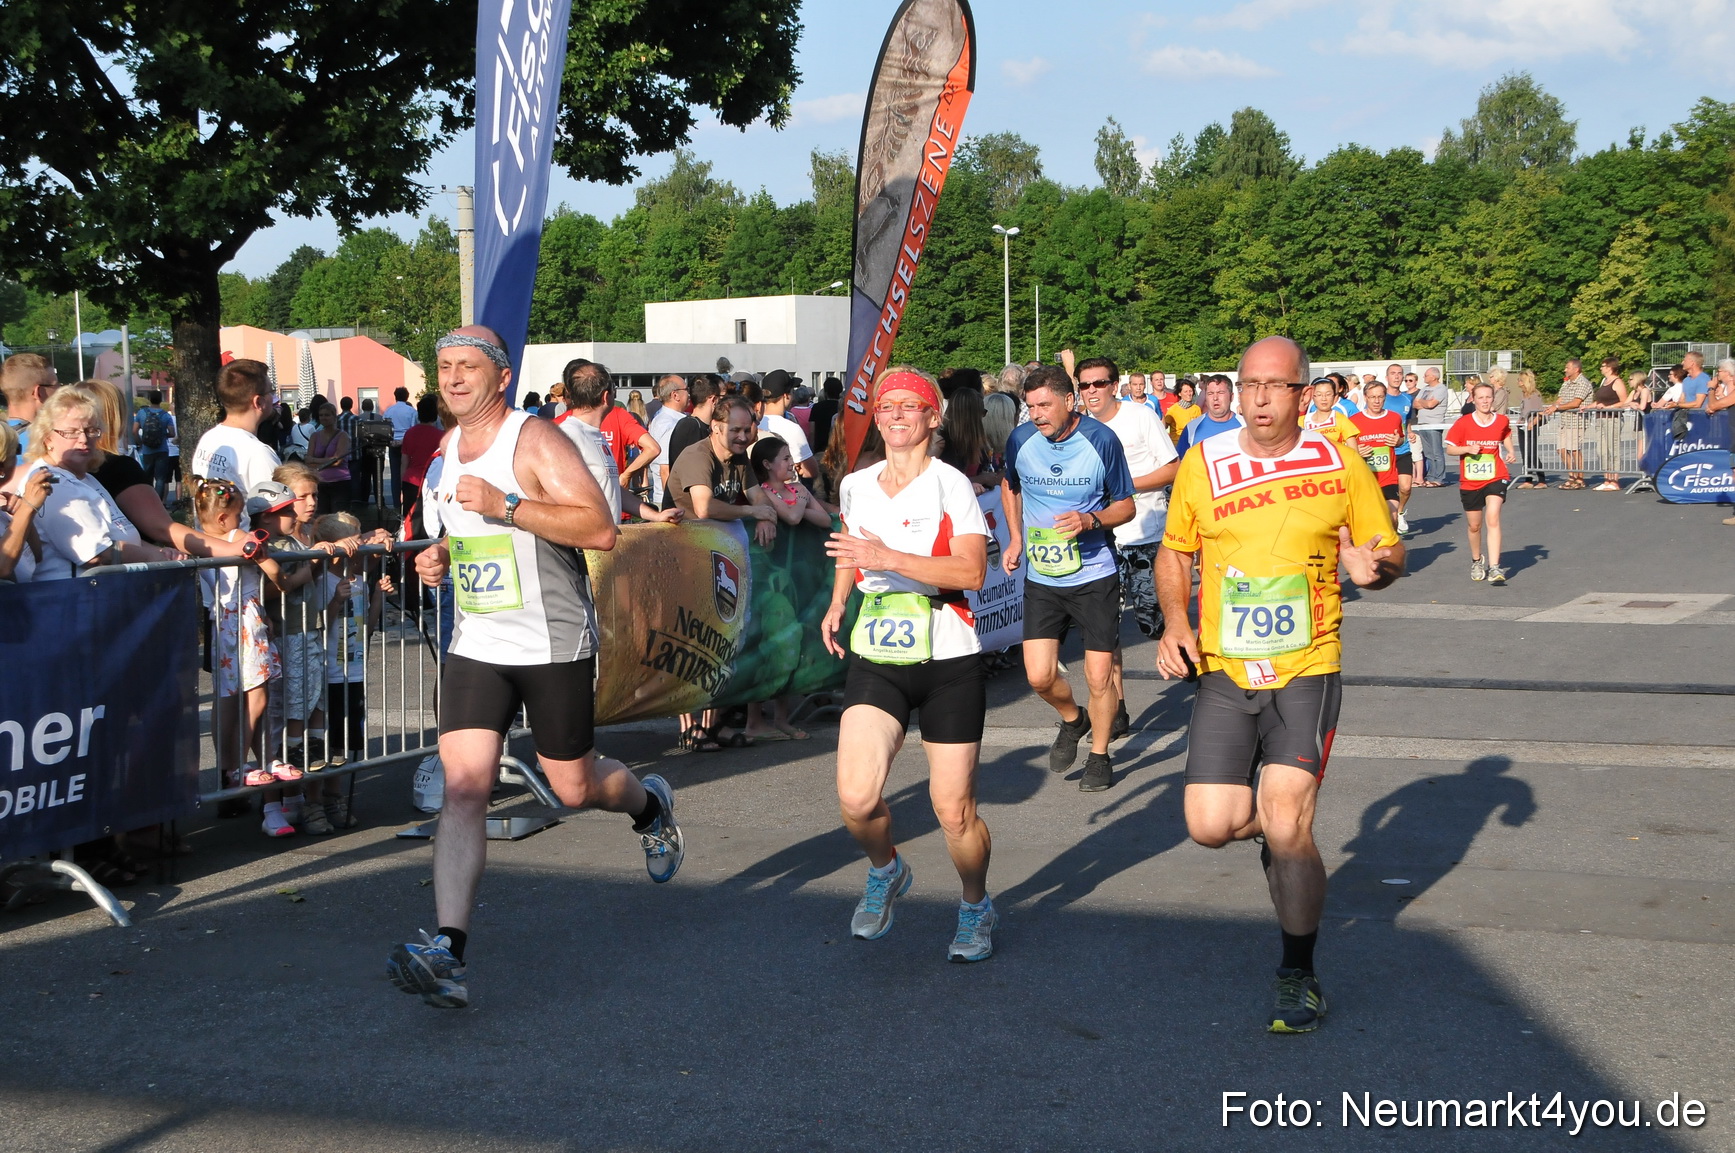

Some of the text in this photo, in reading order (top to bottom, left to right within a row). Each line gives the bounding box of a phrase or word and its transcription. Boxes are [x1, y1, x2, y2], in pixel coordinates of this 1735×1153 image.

[1025, 475, 1091, 486] SCHABMÜLLER
[1466, 463, 1493, 474] 1341
[1213, 478, 1346, 522] MAX BÖGL
[1028, 542, 1074, 564] 1231
[458, 562, 505, 593] 522
[976, 577, 1017, 607] Neumarkter
[864, 618, 916, 649] 123
[1231, 604, 1296, 638] 798
